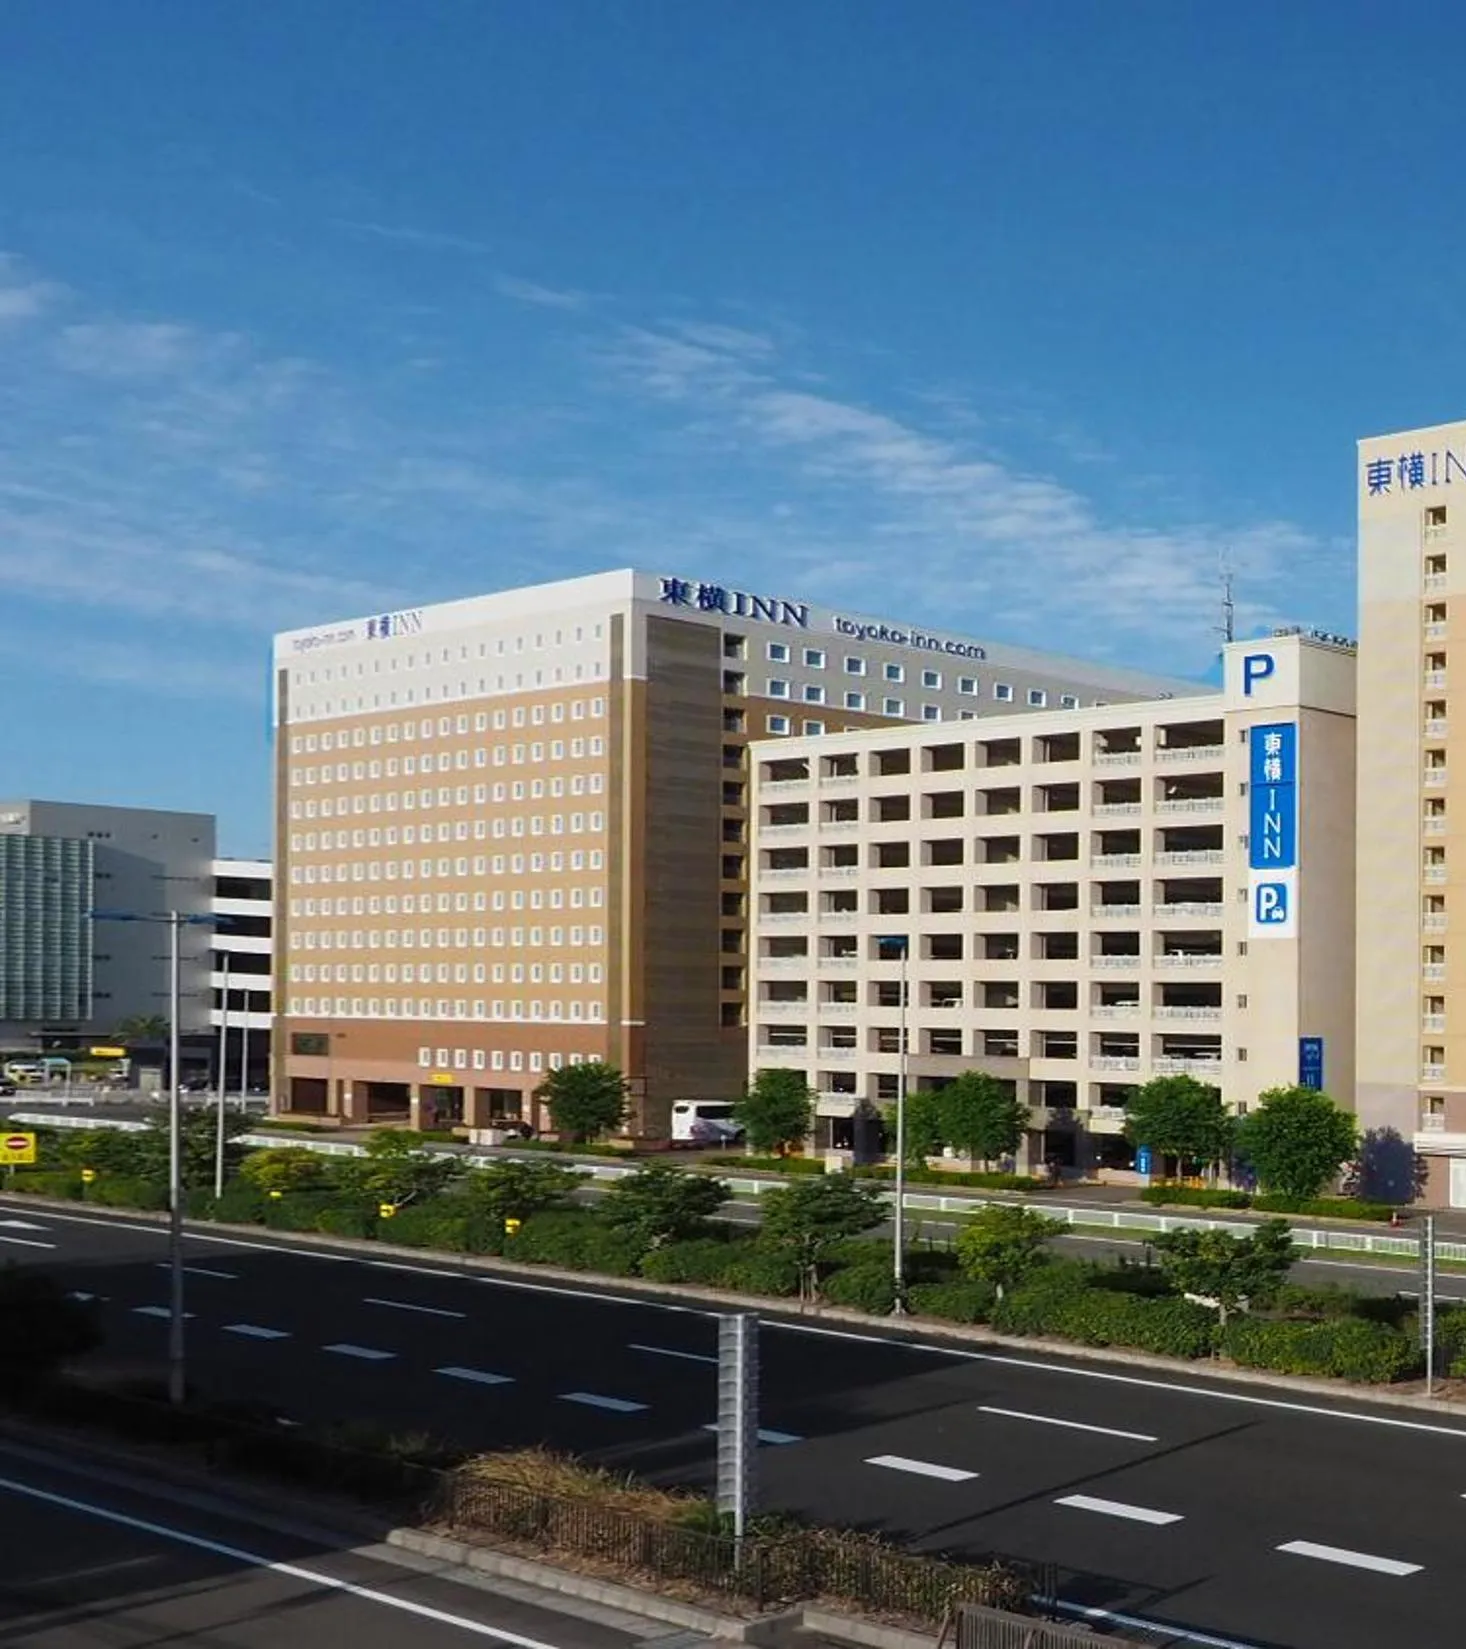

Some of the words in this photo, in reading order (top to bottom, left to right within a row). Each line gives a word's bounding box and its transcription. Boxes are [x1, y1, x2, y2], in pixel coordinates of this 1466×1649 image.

[657, 576, 810, 628] 東横INN
[832, 614, 986, 660] toyoko-inn.com
[1243, 653, 1275, 697] P
